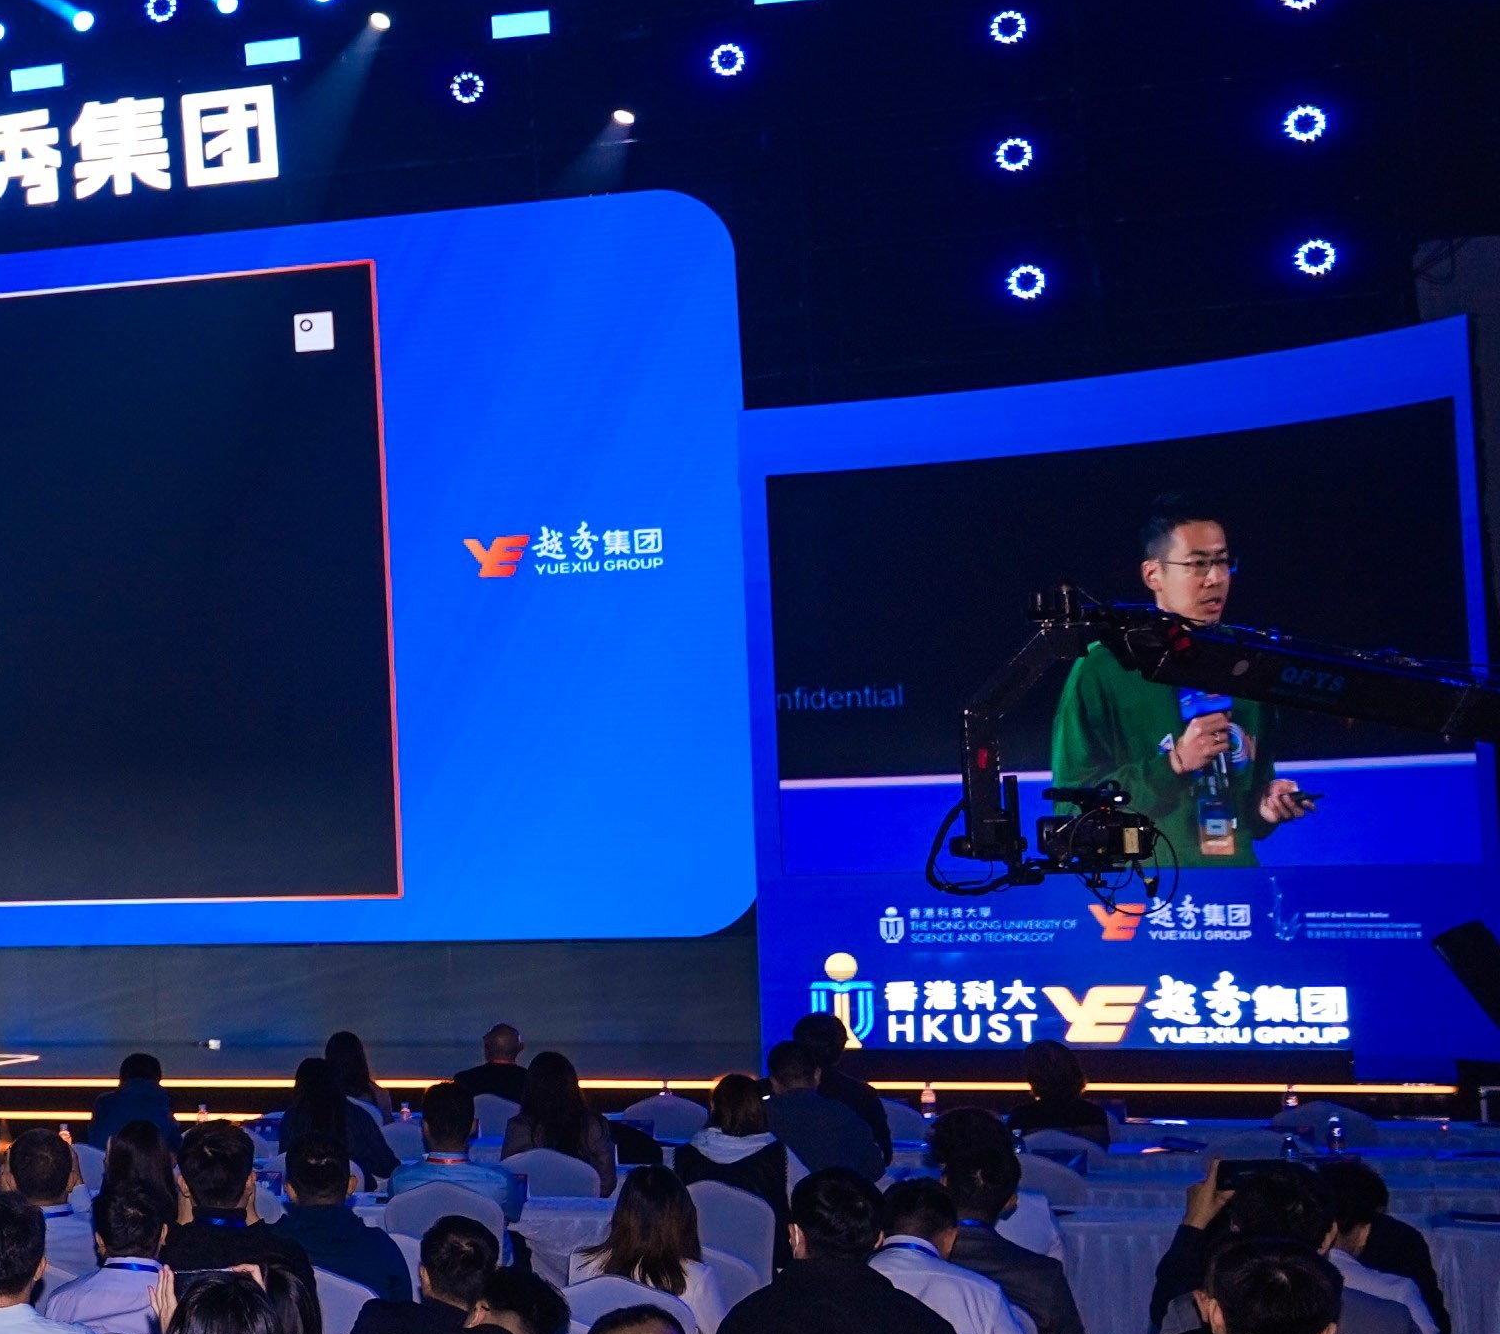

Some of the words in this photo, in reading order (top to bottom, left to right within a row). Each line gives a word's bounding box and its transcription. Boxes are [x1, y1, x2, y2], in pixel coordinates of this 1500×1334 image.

[532, 520, 663, 560] 越秀集团
[535, 560, 601, 575] YUEXIU
[603, 556, 664, 572] GROUP
[1146, 894, 1251, 929] 越秀集团
[910, 920, 928, 931] THE
[931, 920, 965, 931] HONG
[967, 920, 1000, 931] KONG
[1002, 919, 1060, 930] UNIVERSITY
[1063, 919, 1078, 930] OF
[910, 932, 954, 943] SCIENCE
[956, 932, 981, 943] AND
[983, 932, 1055, 942] TECHNOLOGY
[1148, 930, 1201, 941] YUEXIU
[1203, 930, 1252, 941] GROUP
[884, 979, 1037, 1012] 香港科大
[1145, 971, 1348, 1026] 越秀集团
[887, 1013, 1038, 1044] HKUST
[1149, 1025, 1250, 1044] YUEXIU
[1252, 1025, 1350, 1044] GROUP
